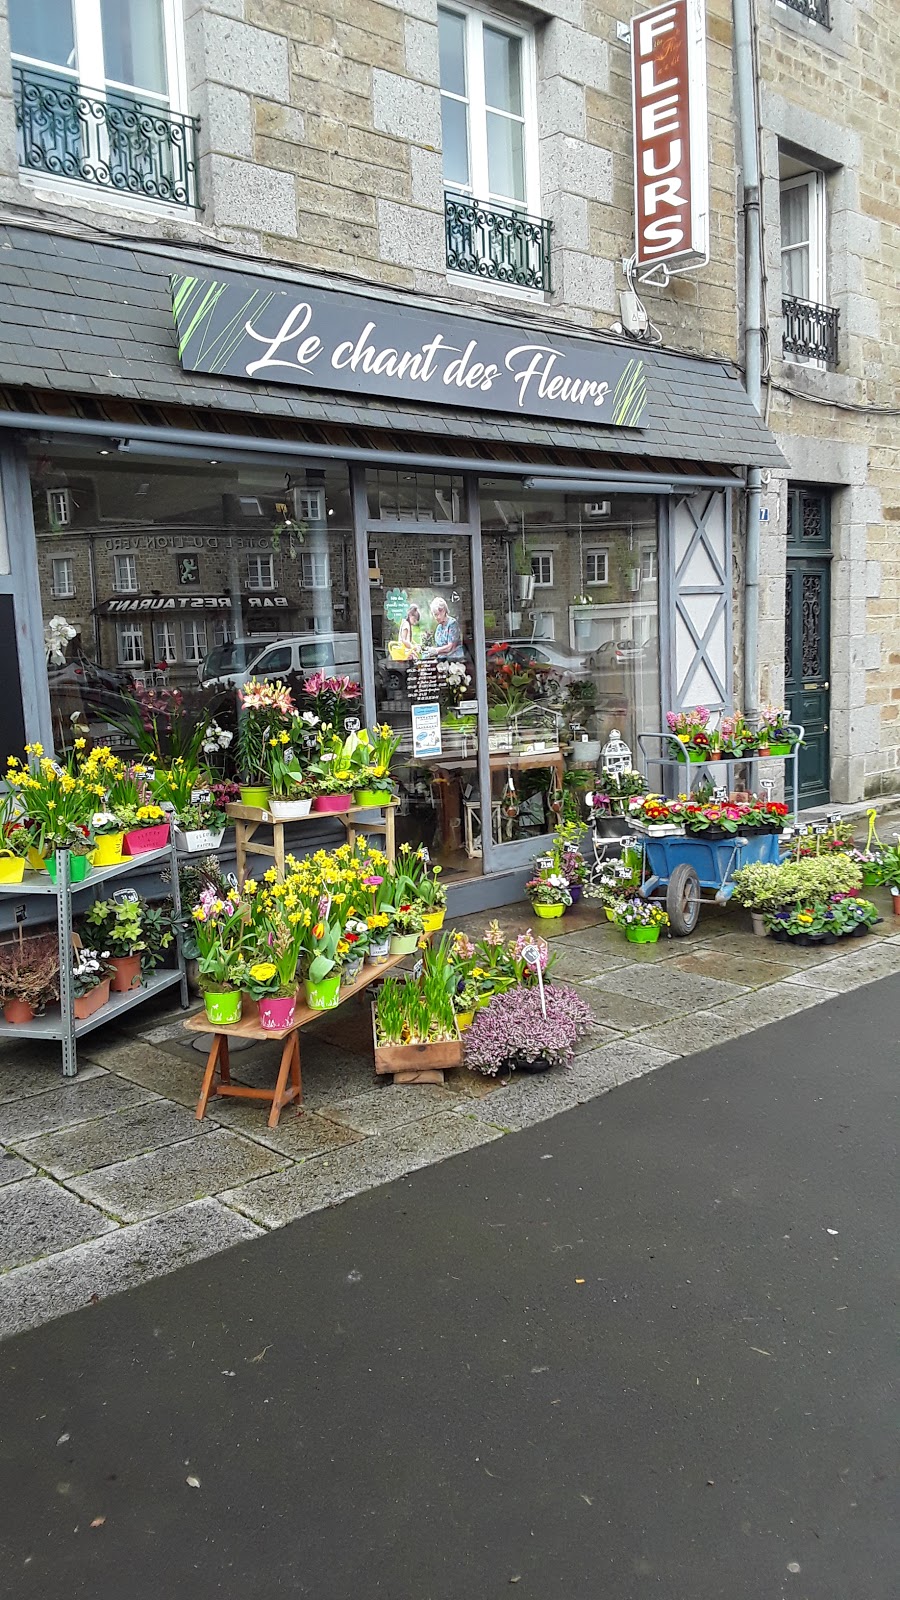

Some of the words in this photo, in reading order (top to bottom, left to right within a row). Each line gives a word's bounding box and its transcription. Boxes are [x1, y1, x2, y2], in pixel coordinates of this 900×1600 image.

[639, 7, 689, 254] FLEURS
[245, 303, 323, 377] Le
[331, 321, 461, 383] chant
[442, 339, 503, 391] des
[505, 344, 613, 407] Fleurs
